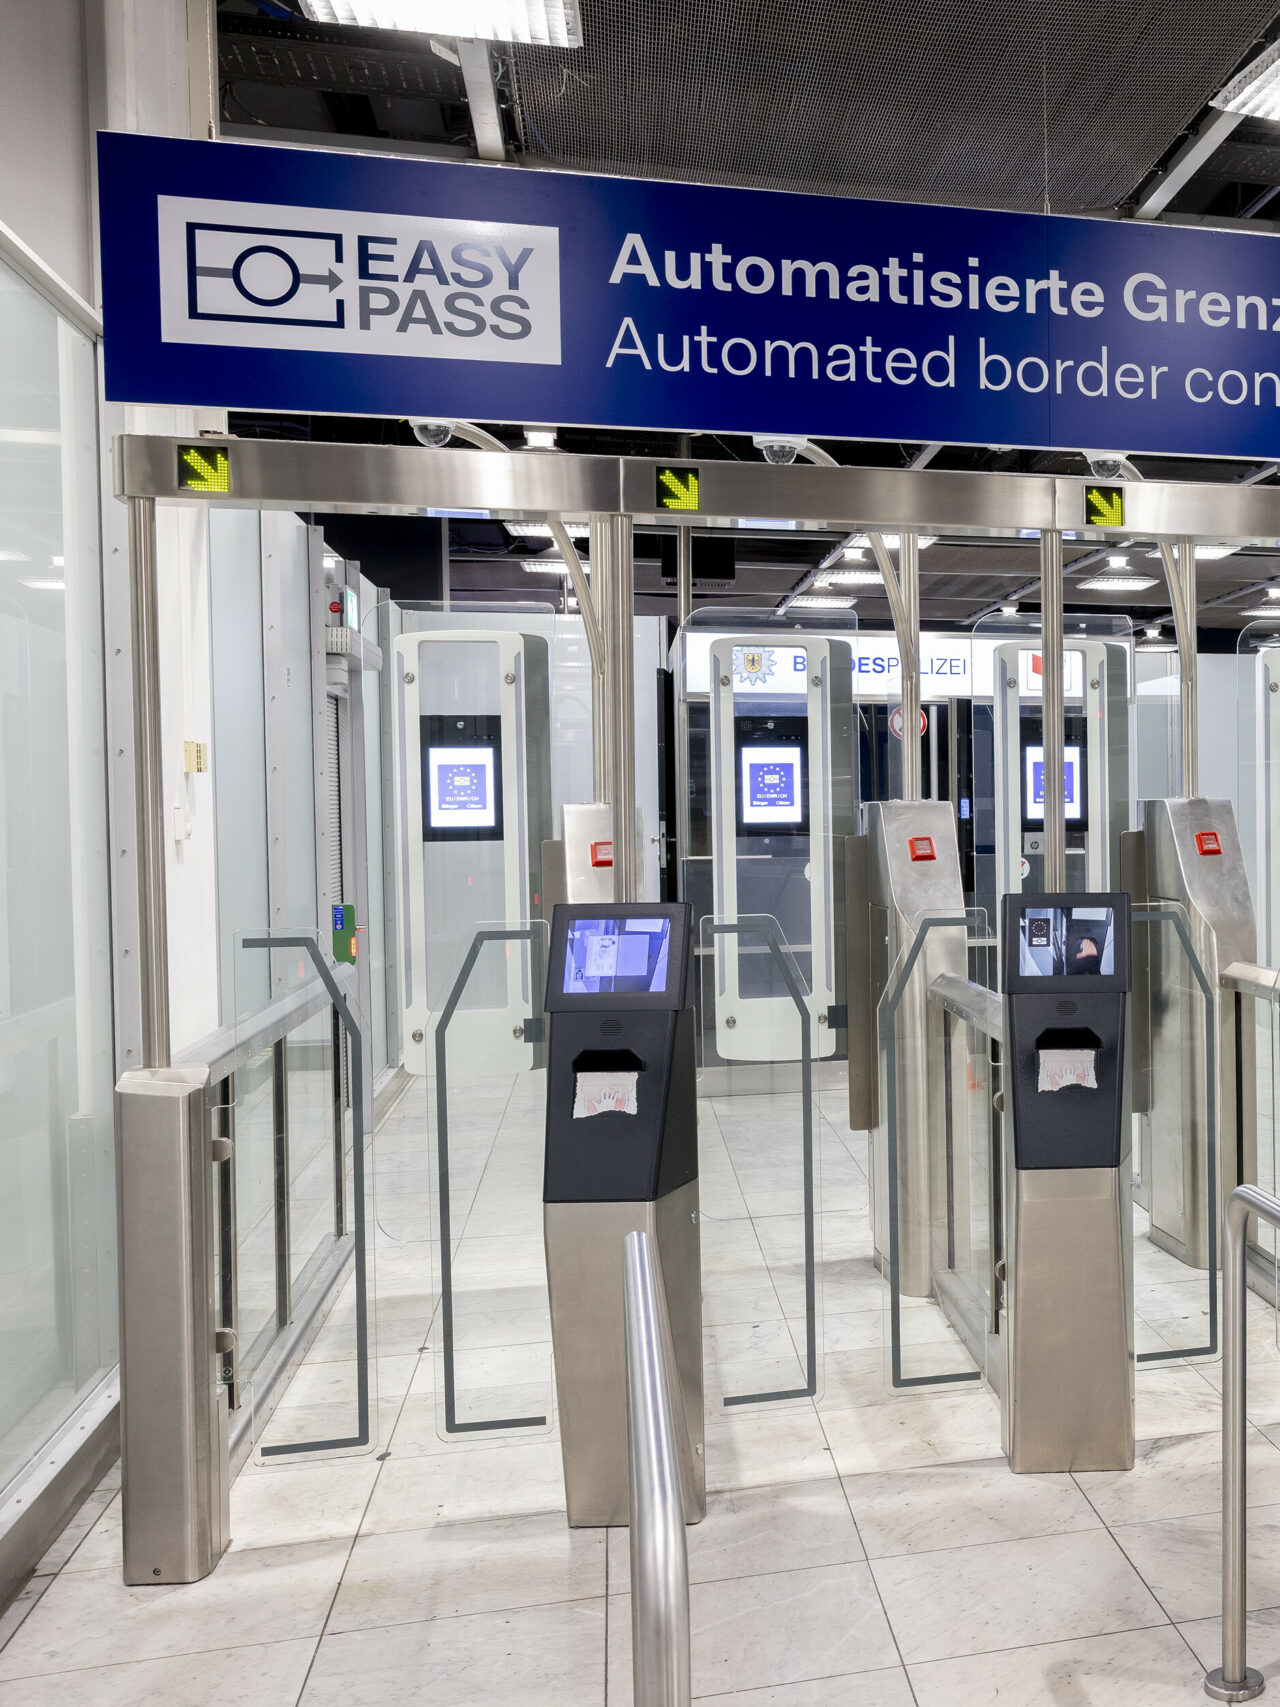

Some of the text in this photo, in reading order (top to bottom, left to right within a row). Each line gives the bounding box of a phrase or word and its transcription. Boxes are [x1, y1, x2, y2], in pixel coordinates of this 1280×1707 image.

[357, 235, 535, 291] EASY
[609, 233, 1105, 318] Automatisierte
[358, 287, 532, 341] PASS
[606, 317, 955, 388] Automated
[979, 338, 1169, 400] border
[793, 655, 966, 675] BESPLIZEI
